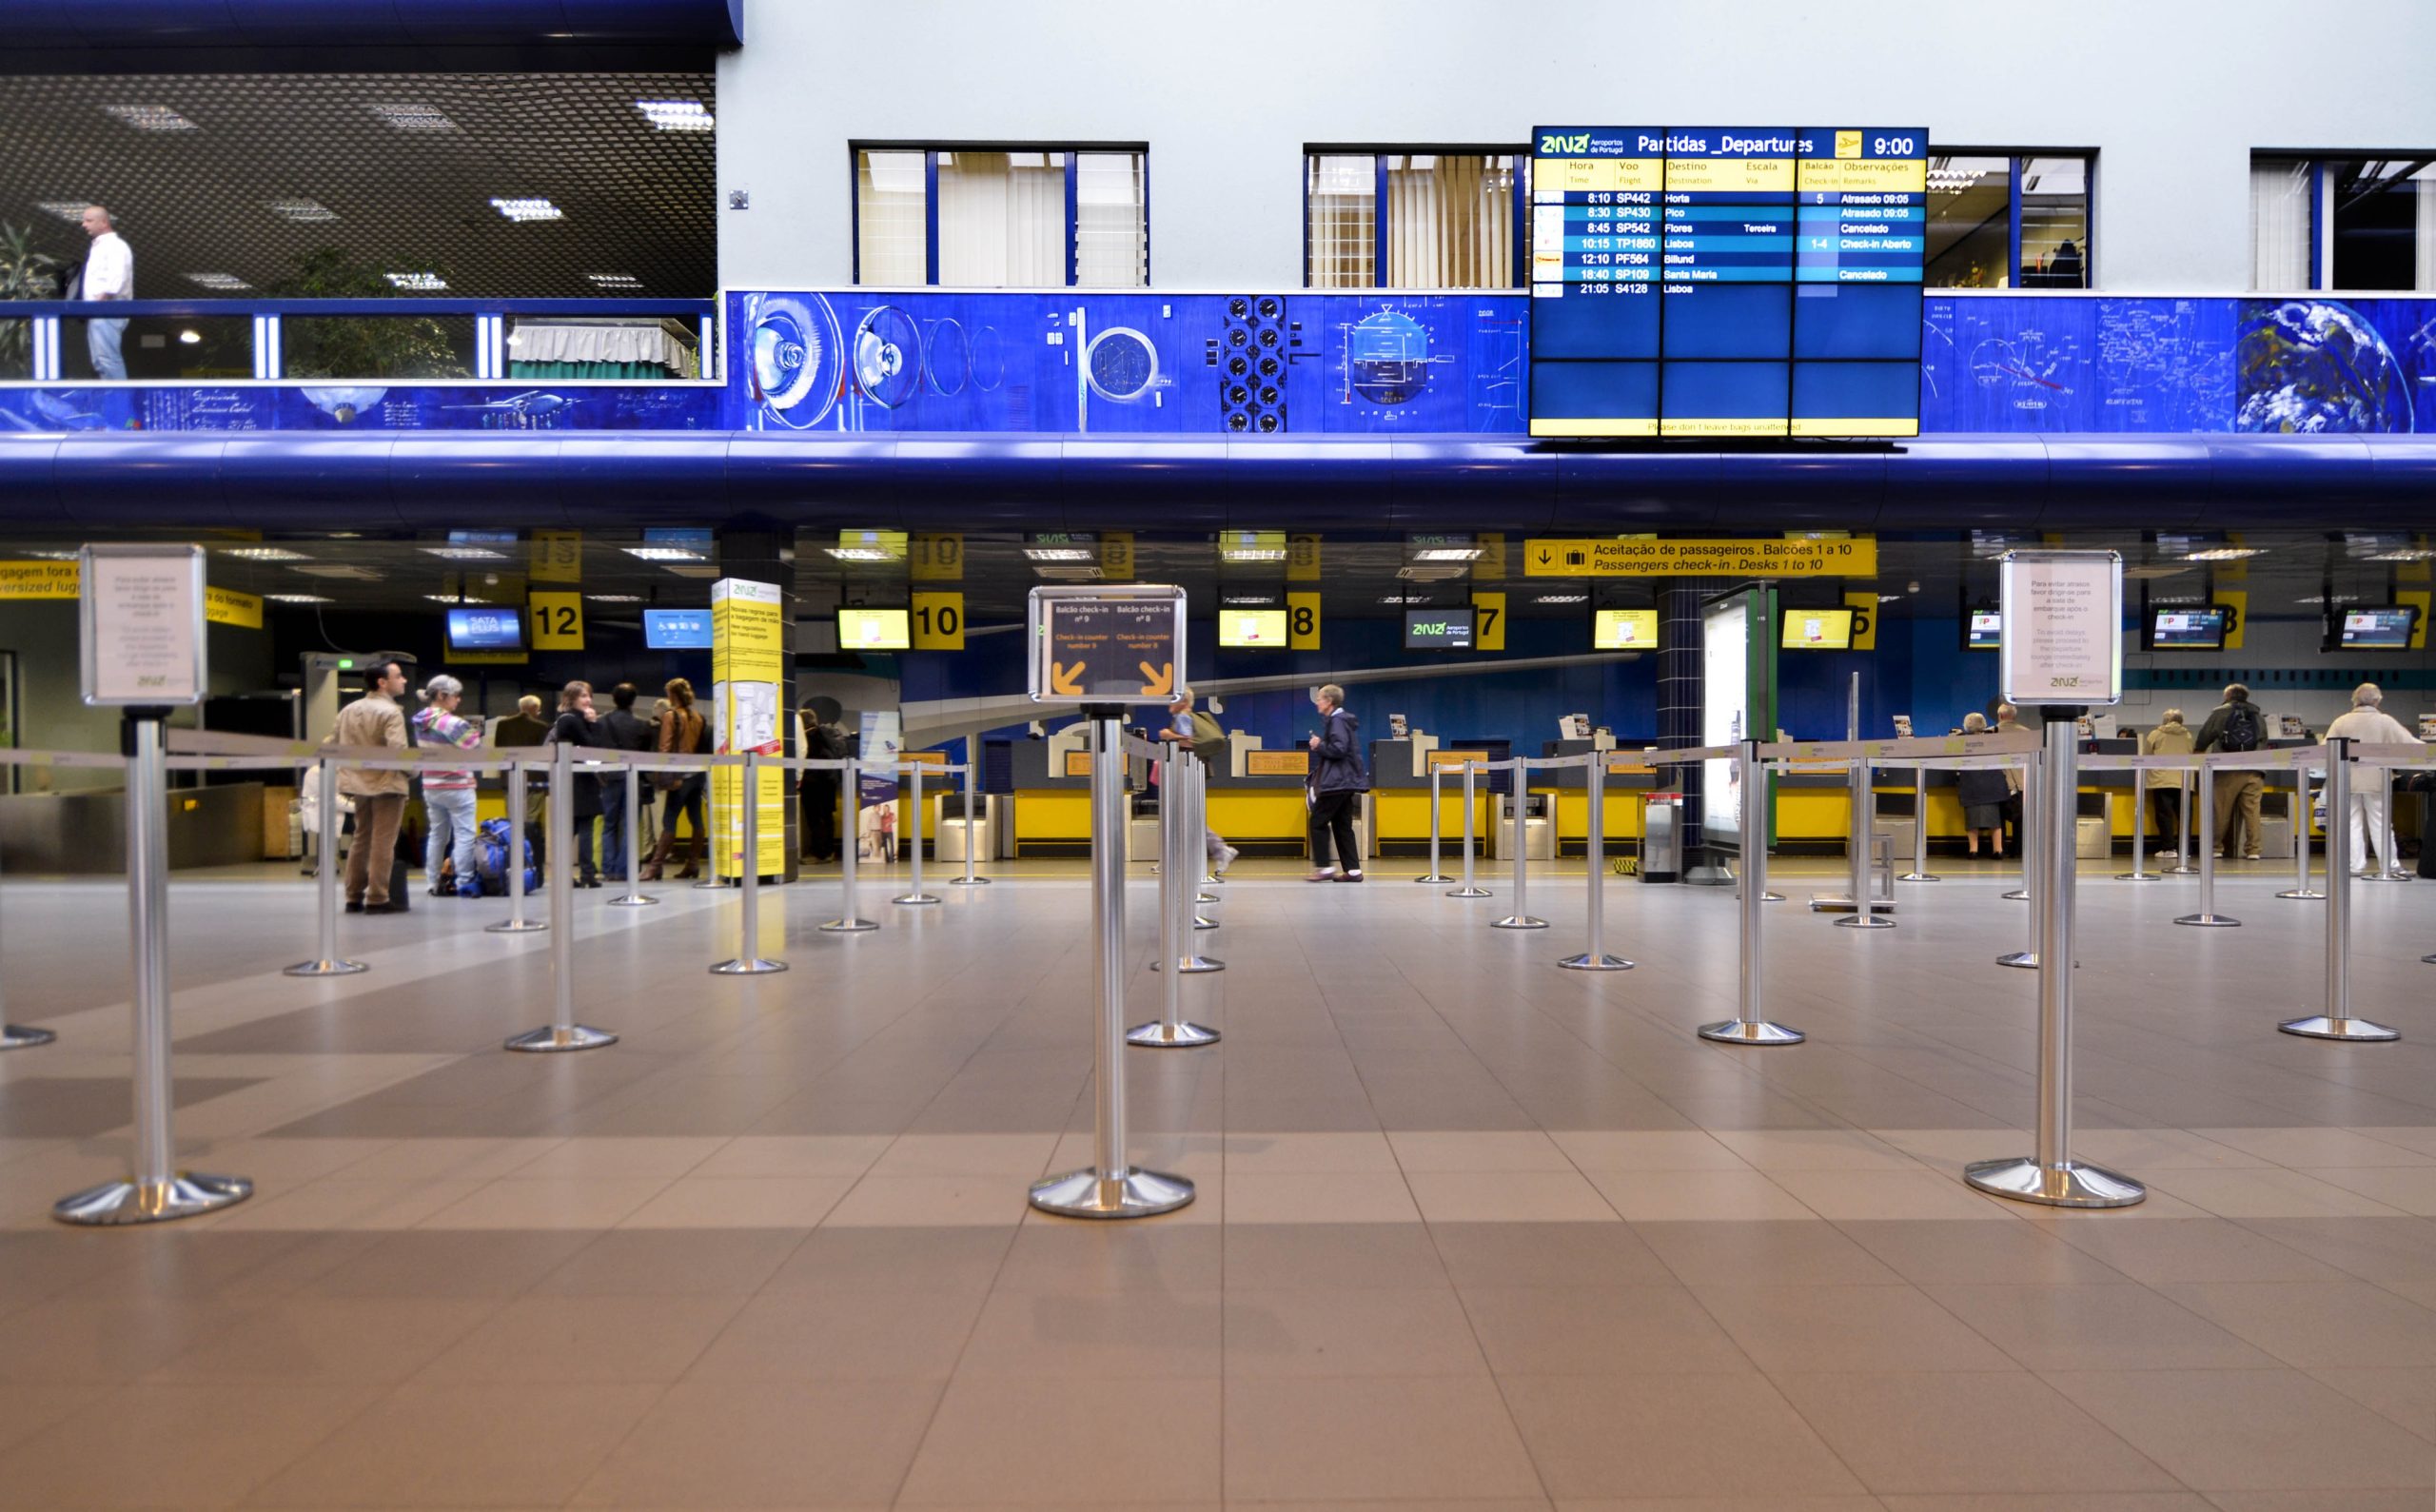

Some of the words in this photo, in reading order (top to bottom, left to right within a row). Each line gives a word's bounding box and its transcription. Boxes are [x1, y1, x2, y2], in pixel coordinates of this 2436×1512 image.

[1638, 135, 1706, 152] Partidas
[1875, 138, 1914, 155] 9:00
[1599, 146, 1623, 154] Portugal
[1569, 162, 1594, 170] Hora
[1620, 162, 1639, 170] Voo
[1668, 162, 1707, 170] Destino
[1746, 162, 1778, 170] Escala
[1805, 162, 1834, 170] Balcão
[1844, 163, 1909, 173] Observações
[1620, 176, 1641, 186] Flight
[1587, 193, 1610, 204] 8:10
[1617, 193, 1651, 204] SP442
[1665, 194, 1690, 204] Horta
[1817, 194, 1823, 204] 5
[1841, 194, 1881, 205] Atrasado
[1883, 194, 1909, 205] 09:05
[1587, 207, 1610, 217] 8:30
[1617, 207, 1651, 217] SP430
[1665, 208, 1685, 217] Pico
[1841, 208, 1881, 218] Atrasado
[1883, 208, 1909, 218] 09:05
[1587, 223, 1610, 233] 8:45
[1616, 223, 1650, 233] SP542
[1664, 224, 1693, 233] Flores
[1743, 224, 1777, 233] Terceira
[1841, 224, 1888, 234] Cancelado
[1581, 239, 1610, 248] 10:15
[1664, 240, 1694, 248] Lisboa
[1812, 240, 1827, 248] 1-4
[1840, 240, 1880, 249] Check-in
[1881, 240, 1912, 249] Aberto
[1581, 254, 1610, 264] 12:10
[1616, 254, 1649, 264] PF564
[1664, 255, 1694, 264] Billund
[1581, 269, 1609, 279] 18:40
[1615, 269, 1650, 279] SP109
[1663, 270, 1690, 279] Santa
[1692, 270, 1718, 279] Maria
[1839, 270, 1887, 280] Cancelado
[1581, 284, 1609, 294] 21:05
[1615, 284, 1648, 294] S4128
[1663, 285, 1693, 294] Lisboa
[1594, 543, 1656, 559] Aceitação
[1660, 543, 1676, 556] de
[1764, 543, 1813, 556] Balcões
[1817, 544, 1822, 555] 1
[1826, 546, 1834, 555] a
[1837, 544, 1852, 555] 10
[47, 565, 71, 578] fora
[1594, 560, 1669, 573] Passengers
[1739, 560, 1778, 570] Desks
[1783, 560, 1789, 570] 1
[1792, 560, 1804, 570] to
[1809, 560, 1823, 570] 10
[1055, 605, 1078, 614] Balcão
[1079, 605, 1109, 614] check-in
[1117, 605, 1140, 614] Balcão
[1141, 605, 1170, 614] check-in
[470, 617, 498, 625] SATA
[535, 606, 578, 636] 12
[916, 606, 958, 636] 10
[1293, 606, 1314, 637] 8
[1479, 607, 1500, 636] 7
